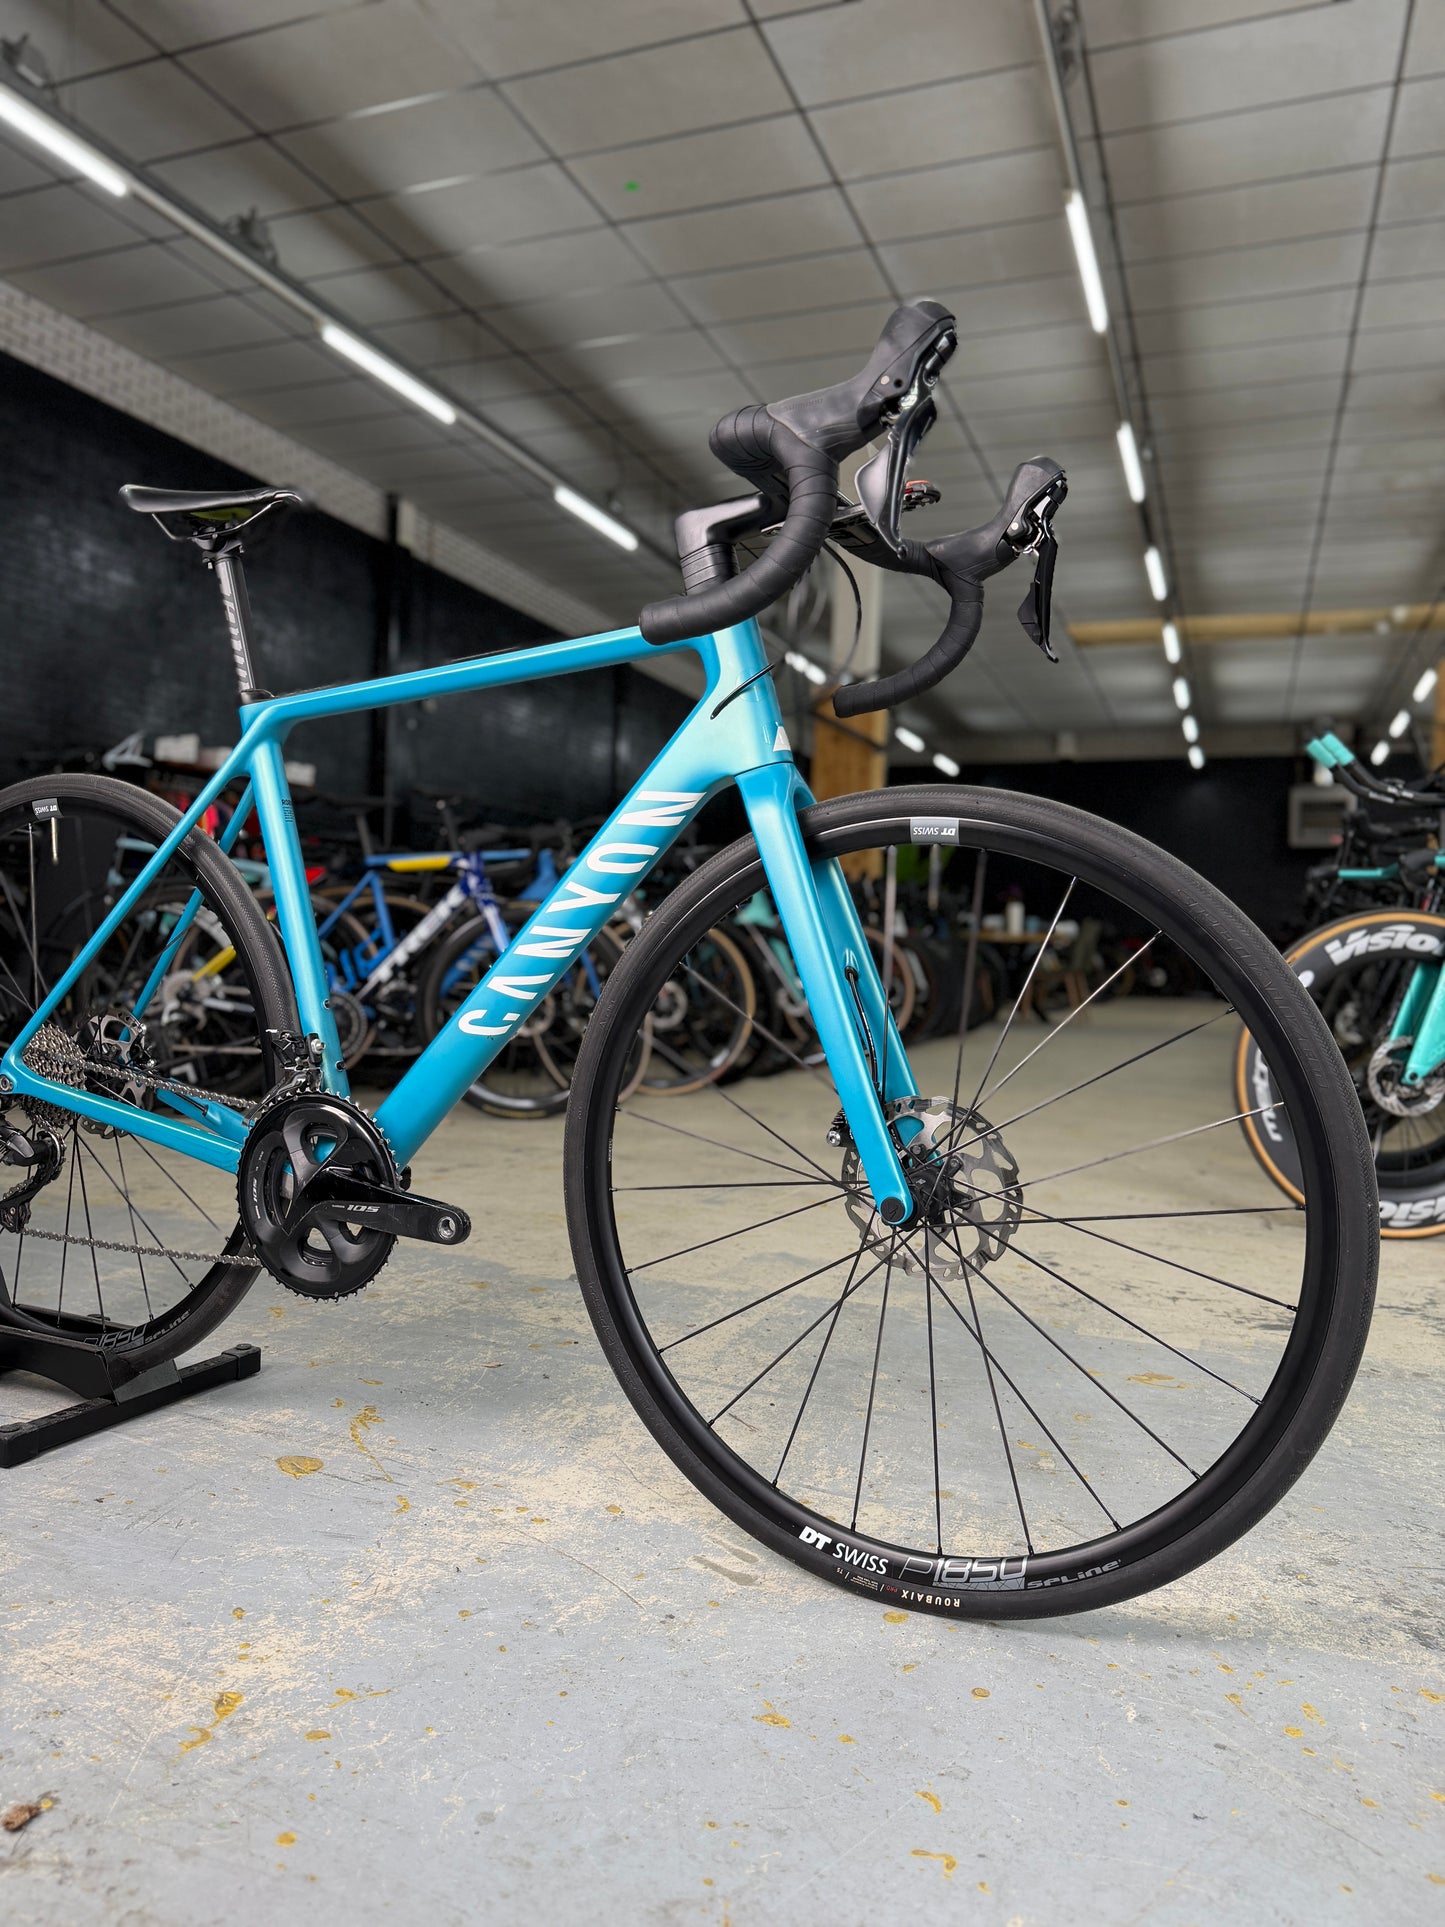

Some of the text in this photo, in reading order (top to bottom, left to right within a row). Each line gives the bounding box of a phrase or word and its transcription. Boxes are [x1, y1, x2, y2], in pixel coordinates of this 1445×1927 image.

[913, 826, 956, 836] DT SWISS
[458, 790, 707, 1036] CANYON
[346, 1204, 381, 1213] 105
[798, 1525, 833, 1550] DT
[832, 1542, 889, 1575] SWISS
[901, 1589, 960, 1608] ROUBAIX
